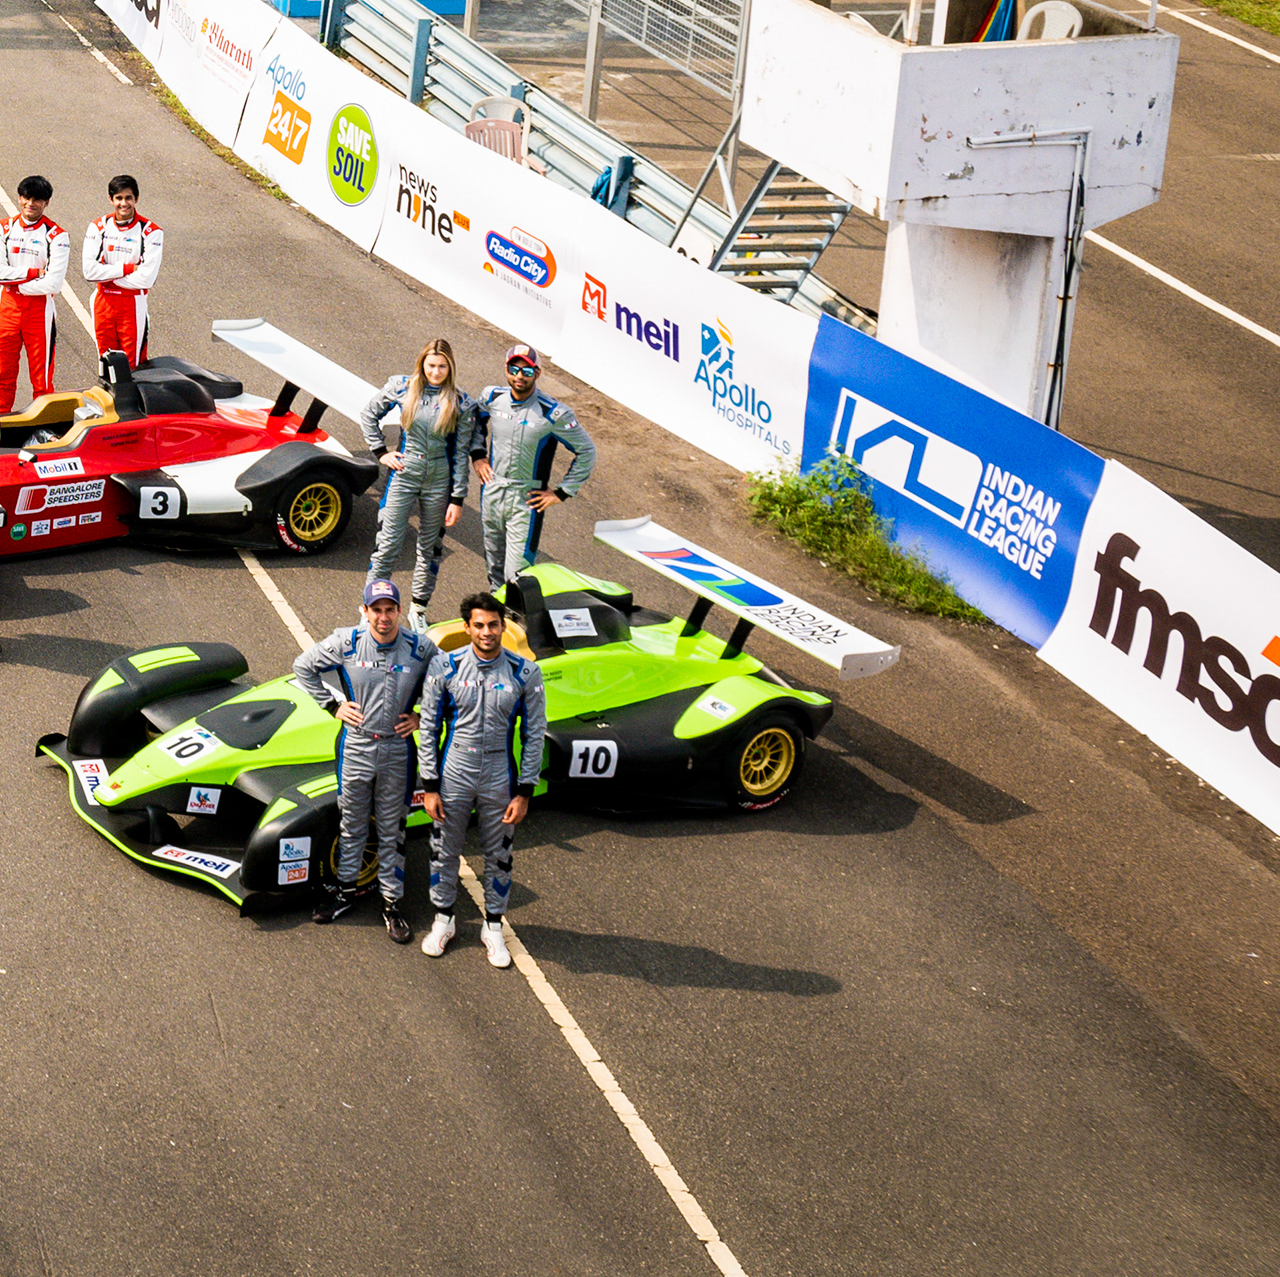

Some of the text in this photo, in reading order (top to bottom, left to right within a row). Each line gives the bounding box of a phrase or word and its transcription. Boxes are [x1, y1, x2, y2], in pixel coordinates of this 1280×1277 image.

[266, 54, 306, 101] Apollo
[335, 115, 371, 161] SAVE
[333, 146, 366, 193] SOIL
[399, 162, 438, 203] news
[489, 237, 546, 283] Radio City
[615, 302, 680, 362] meil
[694, 357, 772, 424] Apollo
[717, 402, 791, 455] HOSPITALS
[38, 464, 67, 475] Mobil
[49, 482, 103, 496] BANGALORE
[47, 491, 102, 505] SPEEDSTERS
[150, 490, 169, 516] 3
[983, 462, 1062, 523] INDIAN
[976, 487, 1057, 558] RACING
[968, 511, 1048, 580] LEAGUE
[743, 607, 818, 645] LEAGUE
[763, 607, 837, 647] RACING
[783, 604, 847, 640] INDIAN
[166, 736, 204, 759] 10
[578, 746, 611, 771] 10
[185, 854, 231, 872] meil
